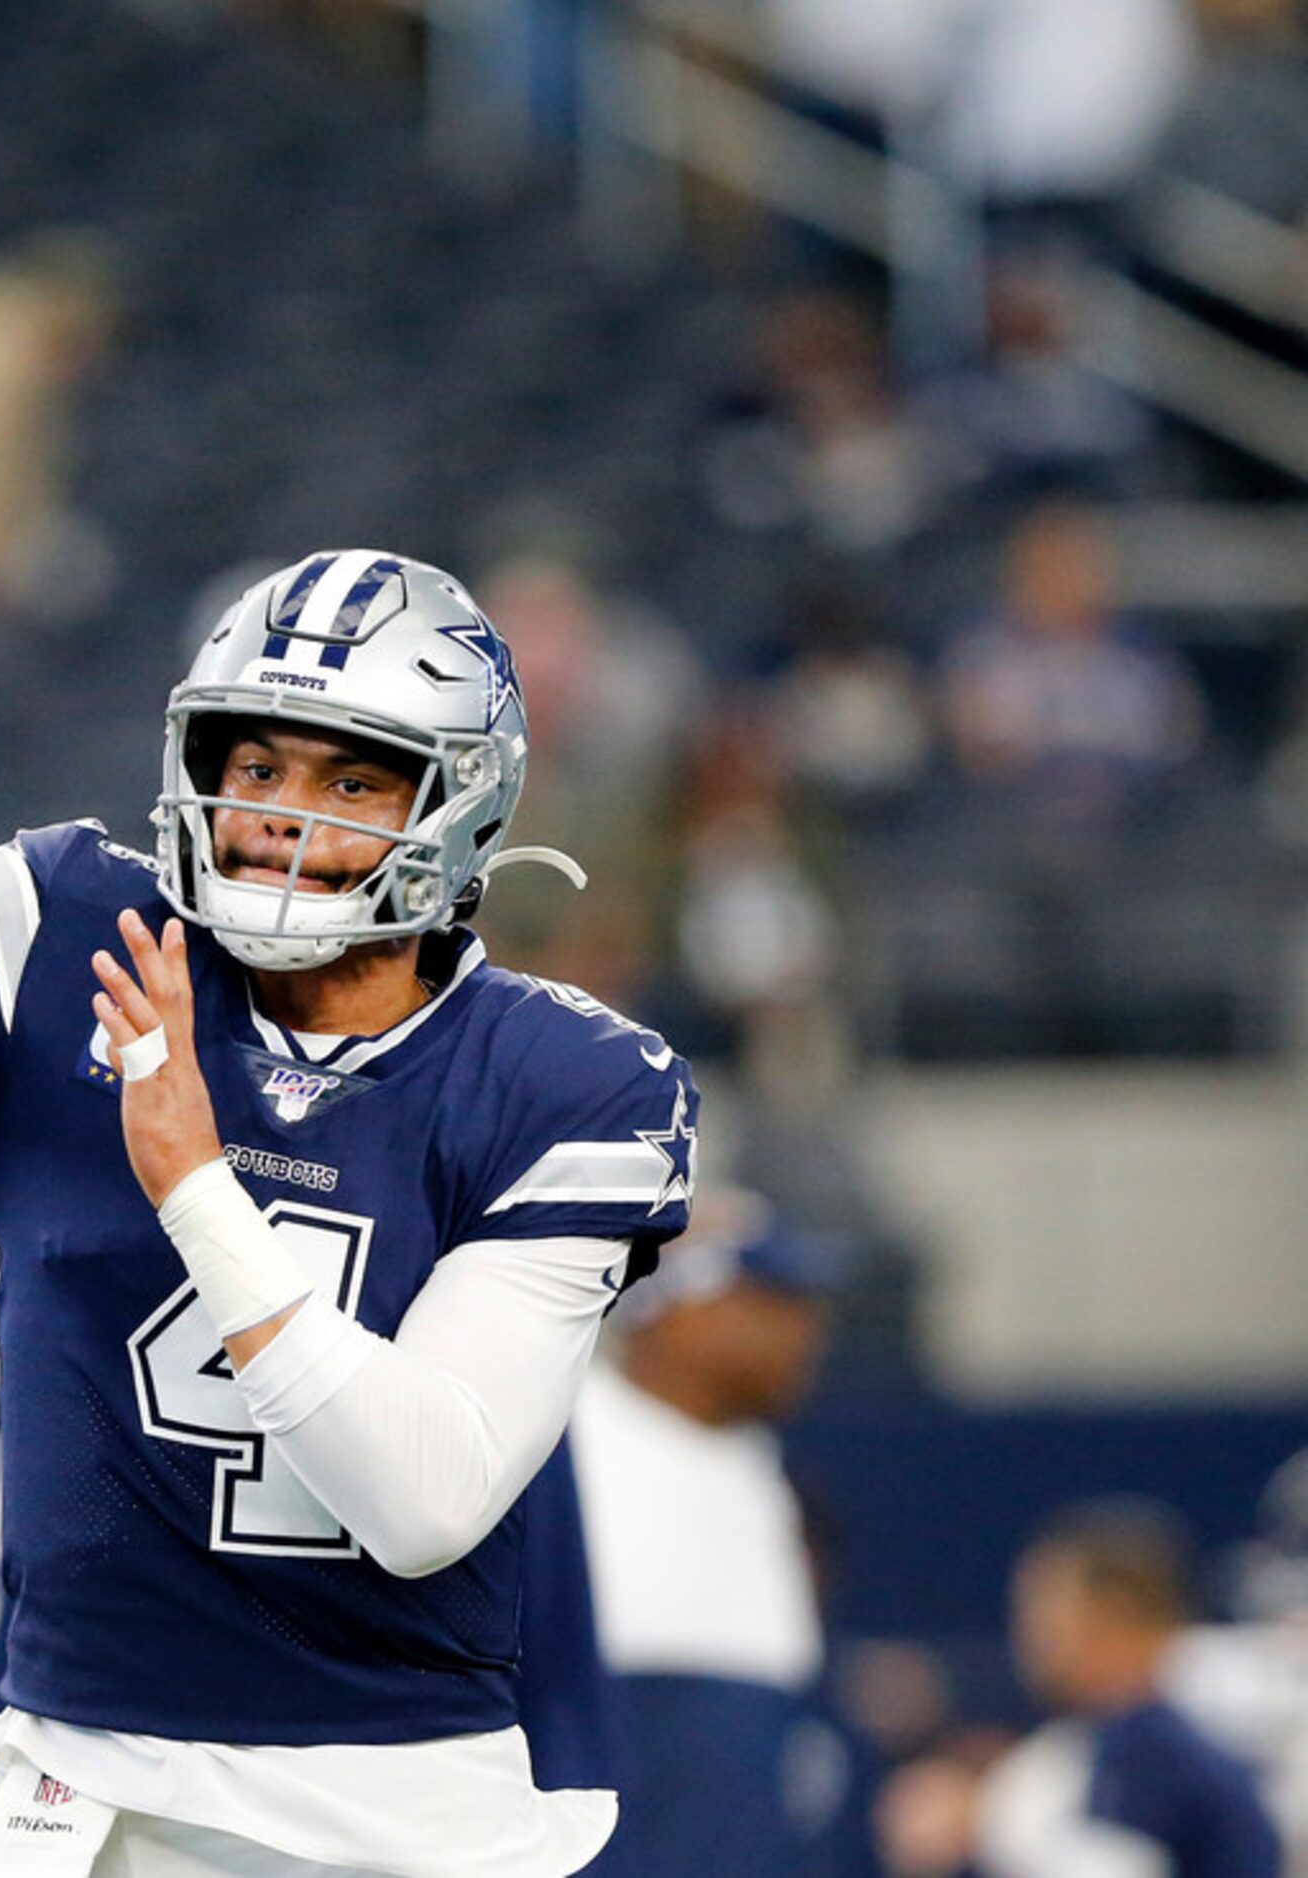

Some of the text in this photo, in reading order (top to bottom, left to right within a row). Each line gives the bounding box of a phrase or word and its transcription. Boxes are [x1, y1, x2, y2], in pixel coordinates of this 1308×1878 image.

[259, 671, 328, 692] COWBOYS
[223, 1144, 339, 1192] COWBOYS
[126, 1198, 375, 1559] 4
